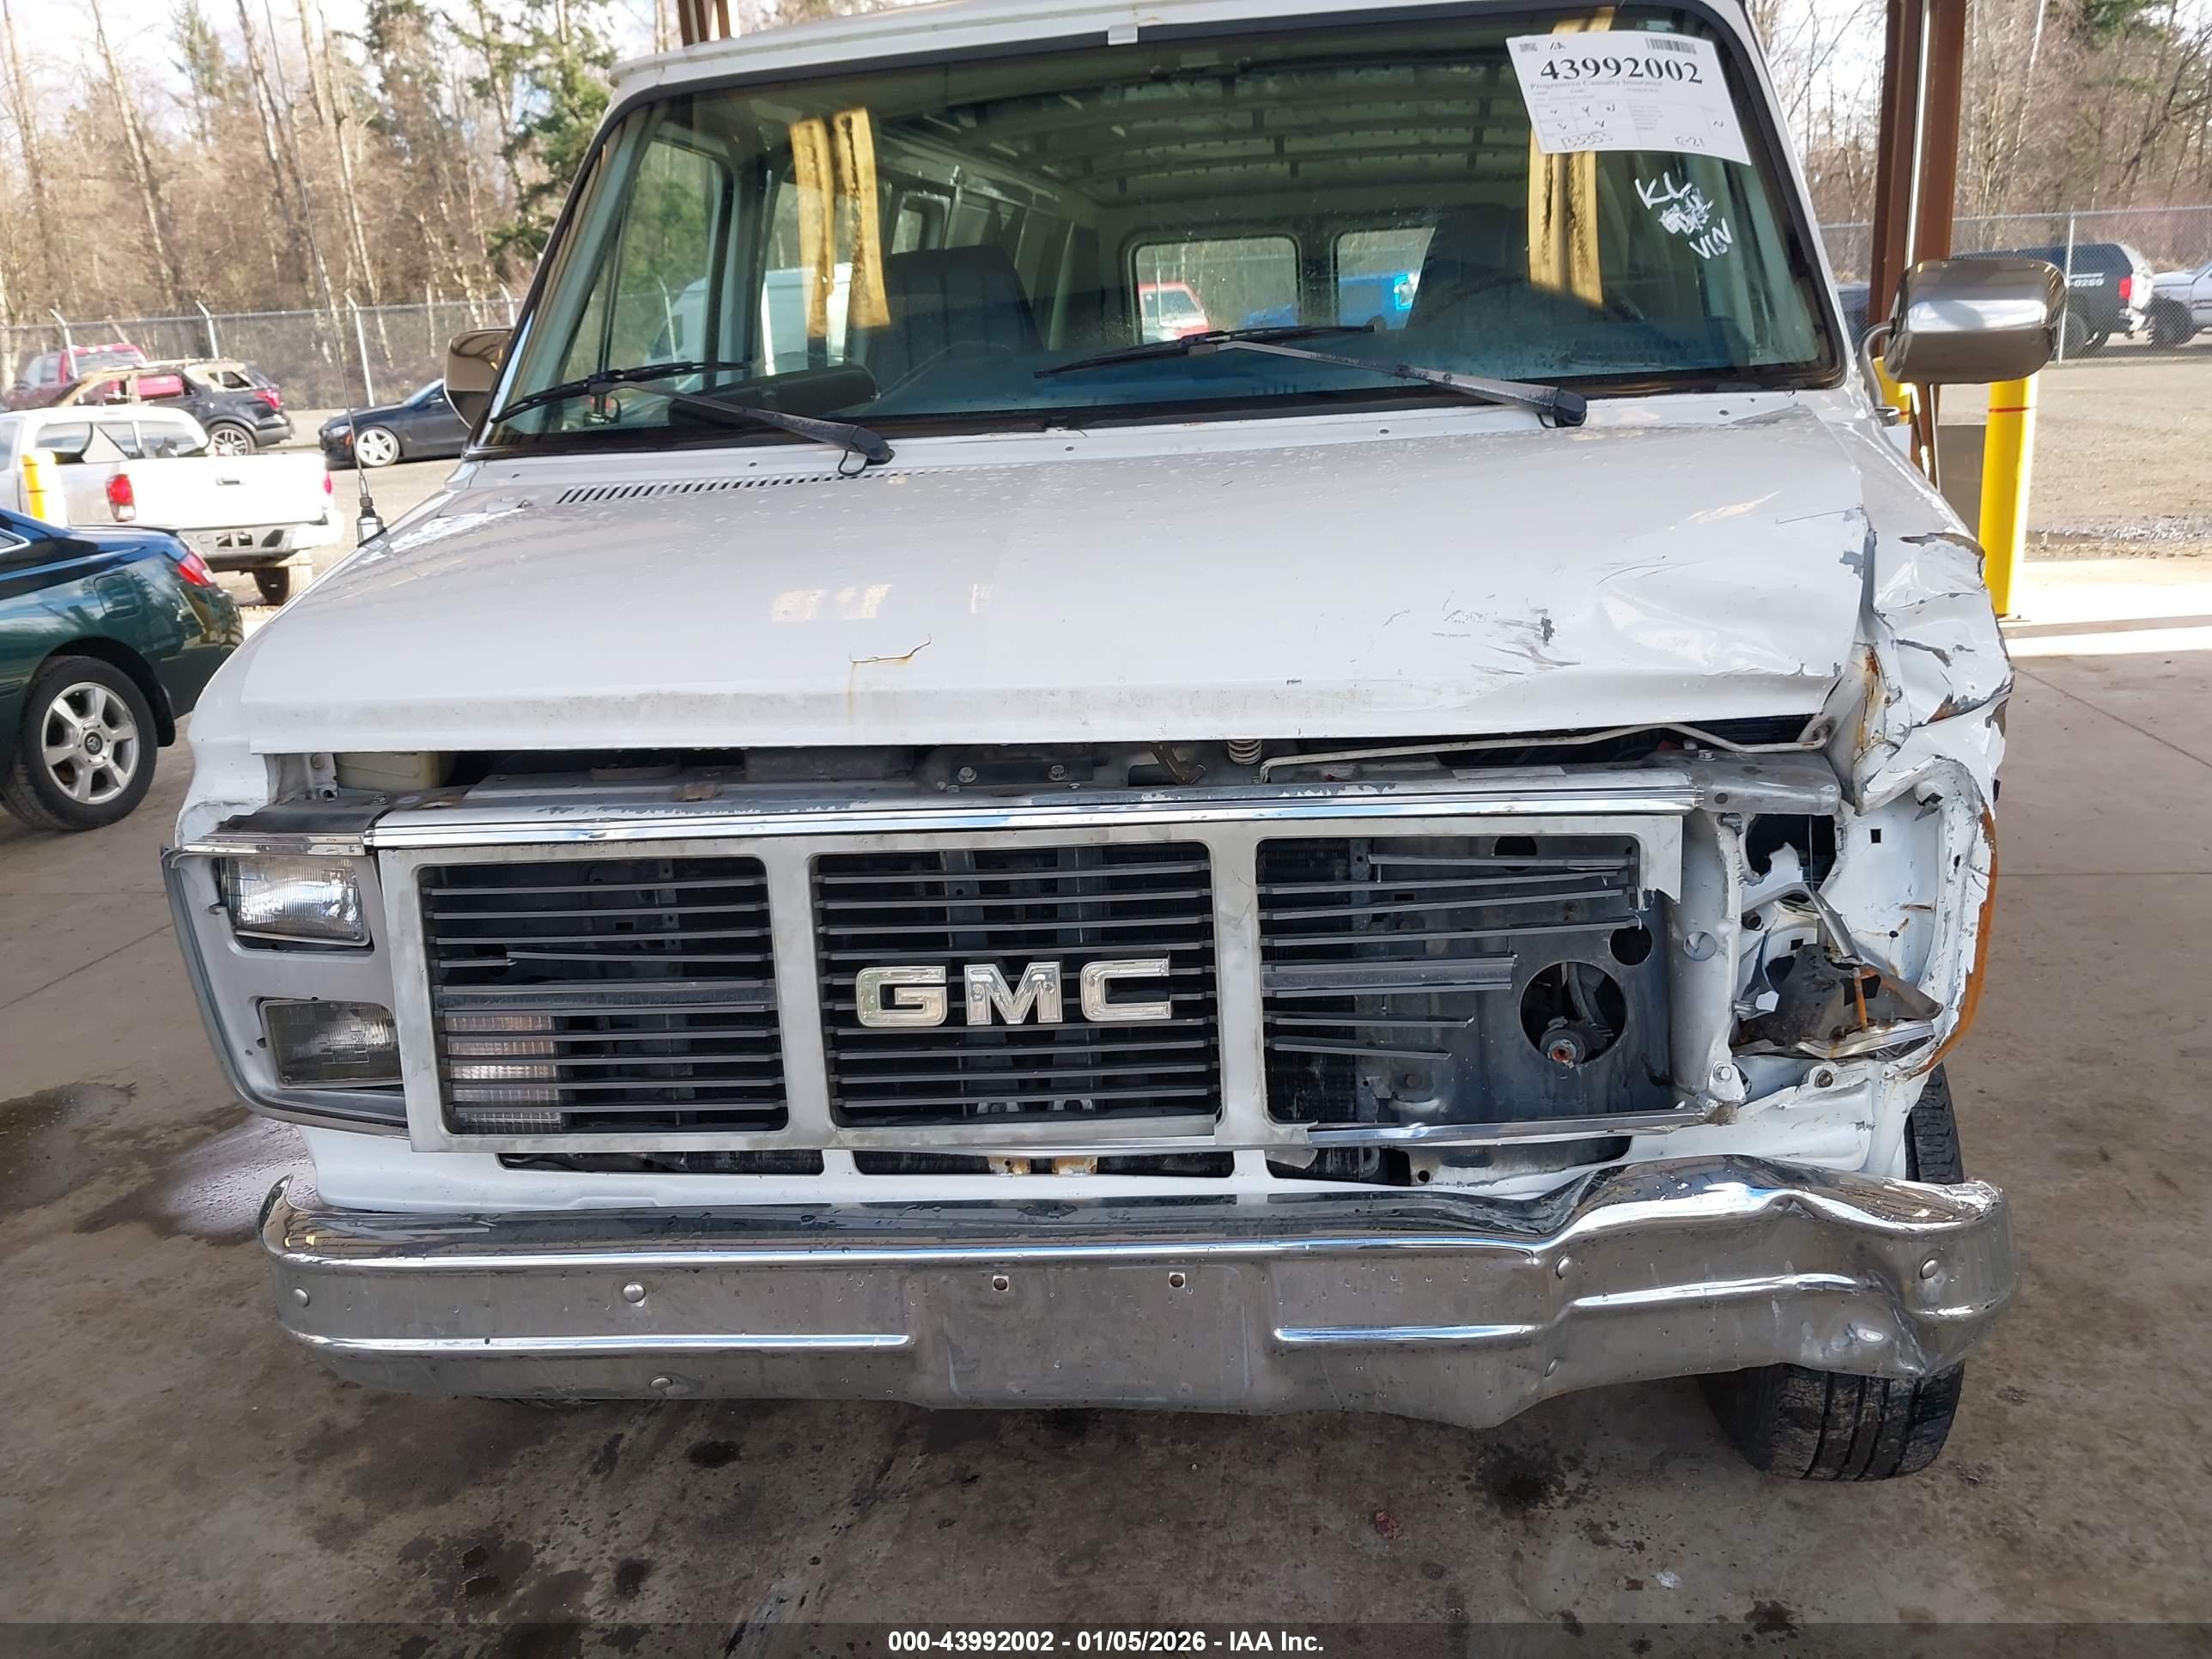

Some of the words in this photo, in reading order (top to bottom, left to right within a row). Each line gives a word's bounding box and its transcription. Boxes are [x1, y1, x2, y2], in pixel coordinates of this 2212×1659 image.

[1540, 57, 1703, 84] 43992002
[1688, 216, 1733, 258] VIN
[855, 957, 1171, 1027] GMC
